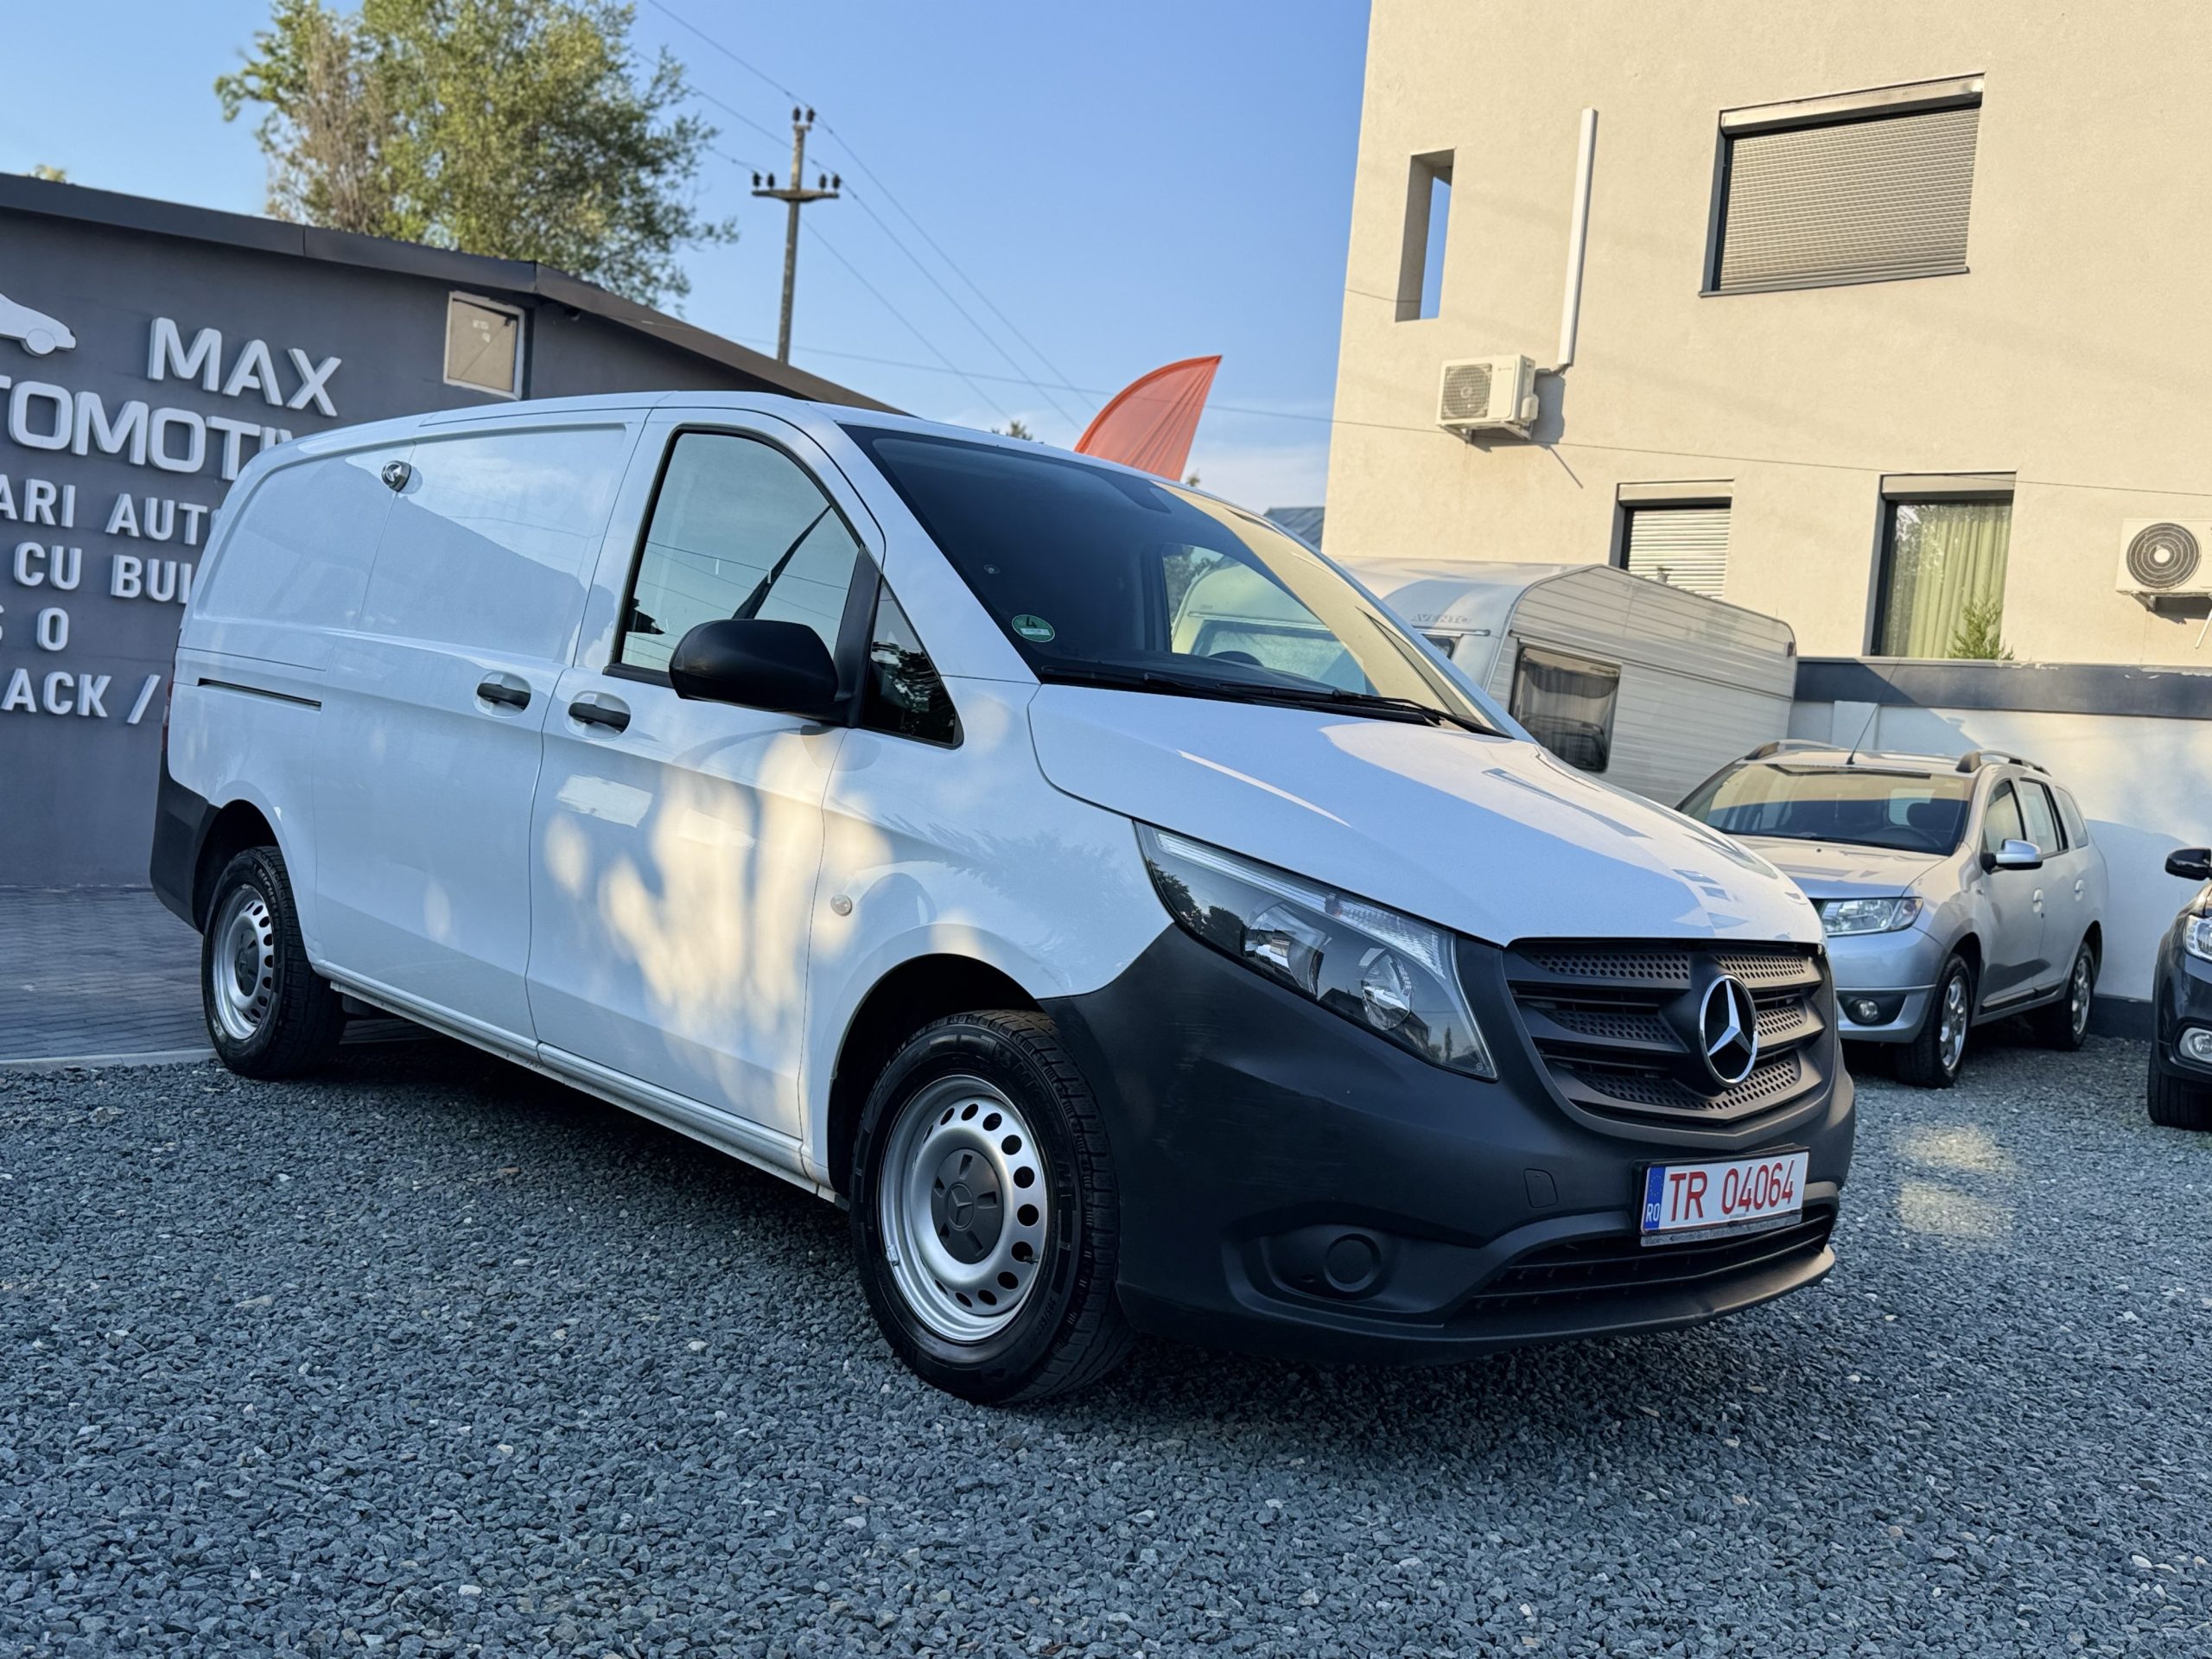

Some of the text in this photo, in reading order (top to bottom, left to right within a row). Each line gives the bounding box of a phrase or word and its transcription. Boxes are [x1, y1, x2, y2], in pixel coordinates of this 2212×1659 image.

[148, 317, 342, 416] MAX
[105, 493, 216, 545] AUT
[14, 542, 82, 590] CU
[1, 668, 162, 724] ACK /
[1645, 1202, 1661, 1224] RO
[1669, 1158, 1796, 1222] TR 04064
